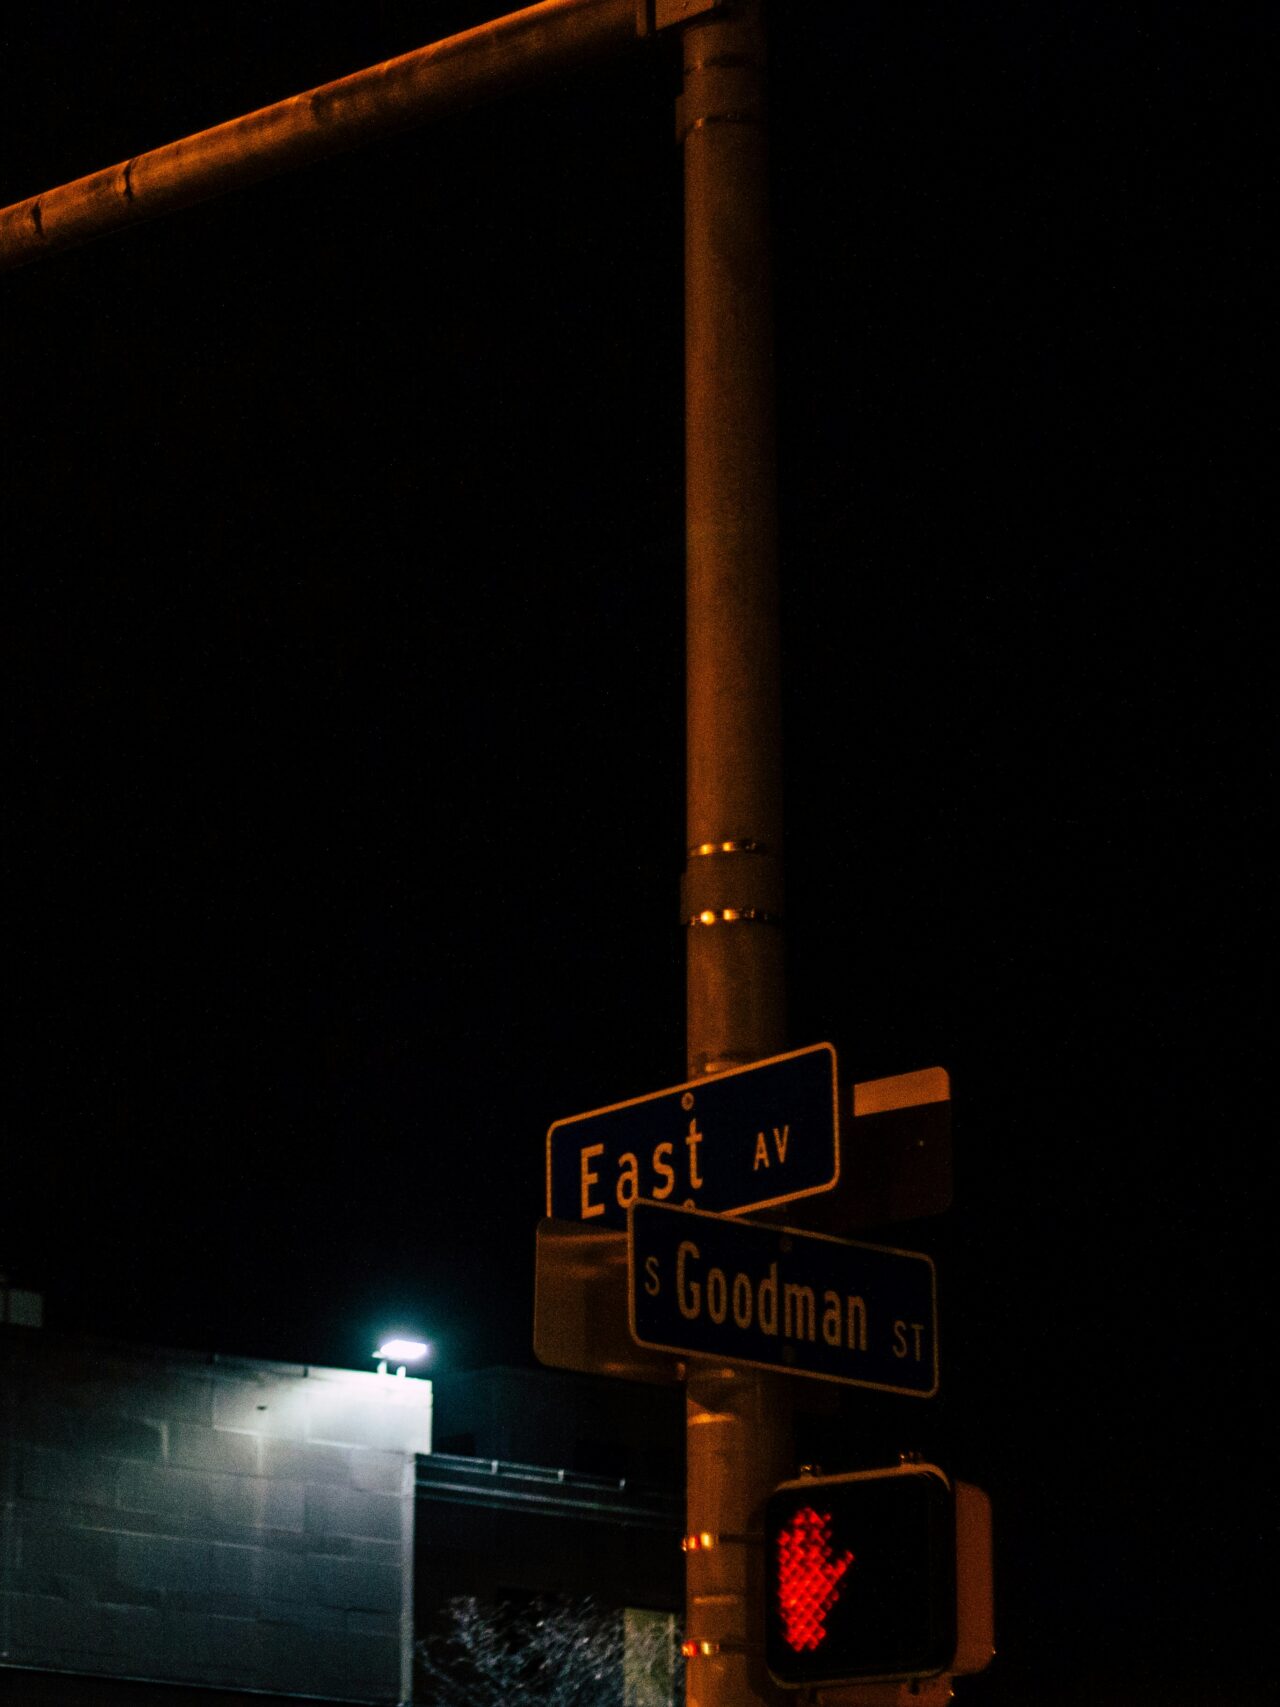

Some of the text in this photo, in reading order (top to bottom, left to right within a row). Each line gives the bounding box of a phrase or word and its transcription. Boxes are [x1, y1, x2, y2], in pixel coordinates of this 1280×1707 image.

[579, 1117, 791, 1220] East AV
[643, 1240, 925, 1362] S Goodman ST
